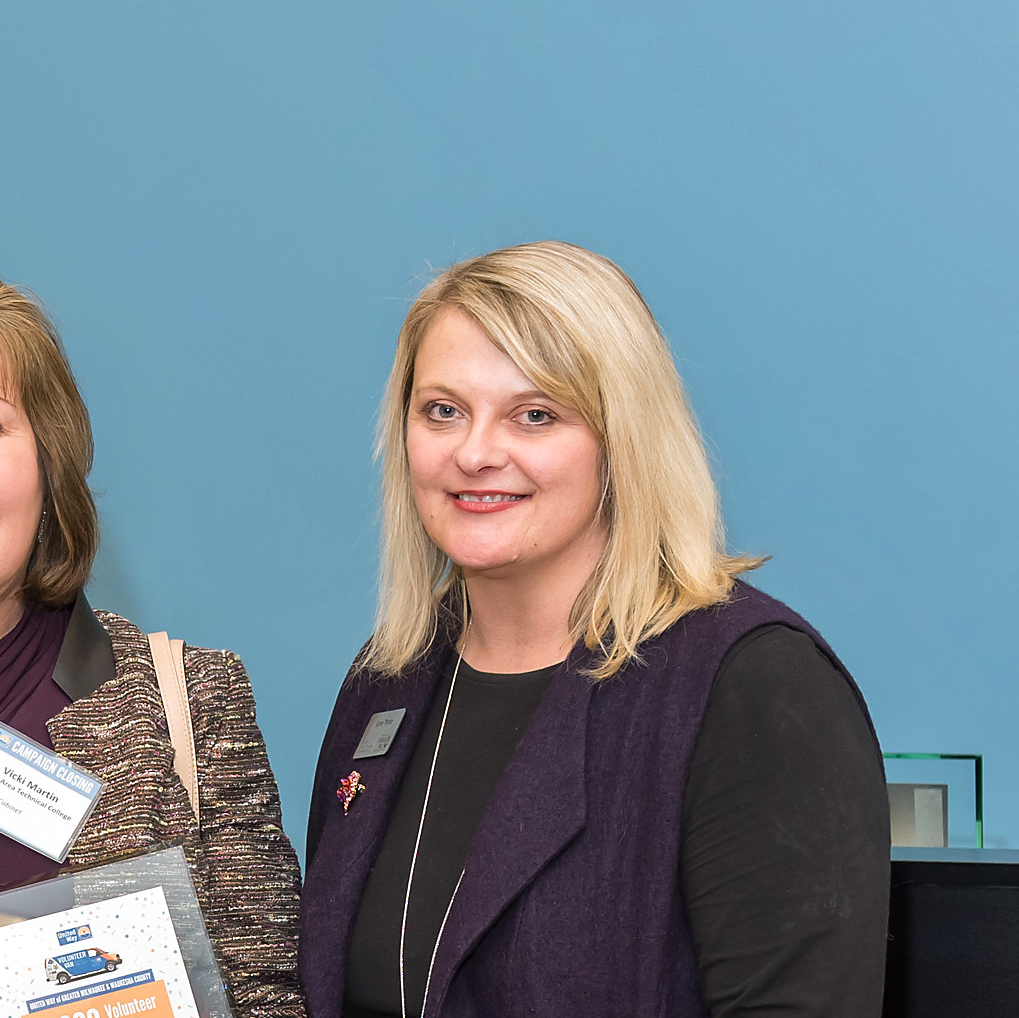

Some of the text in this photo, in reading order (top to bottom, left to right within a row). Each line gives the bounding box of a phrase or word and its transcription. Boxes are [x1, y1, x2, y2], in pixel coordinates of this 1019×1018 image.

[4, 767, 27, 785] Vicki
[27, 781, 59, 803] Martin
[11, 741, 94, 794] CAMPAIGN CLOSING
[0, 778, 16, 791] Area
[17, 788, 47, 808] Technical
[47, 805, 72, 821] College
[58, 929, 76, 938] United
[58, 951, 87, 964] VOLUNTEER
[29, 1001, 46, 1010] UNITED
[62, 991, 80, 1002] GREATER
[80, 985, 106, 997] MILWAUKEE
[110, 978, 134, 988] WAUKESHA
[134, 972, 152, 983] COUNTY
